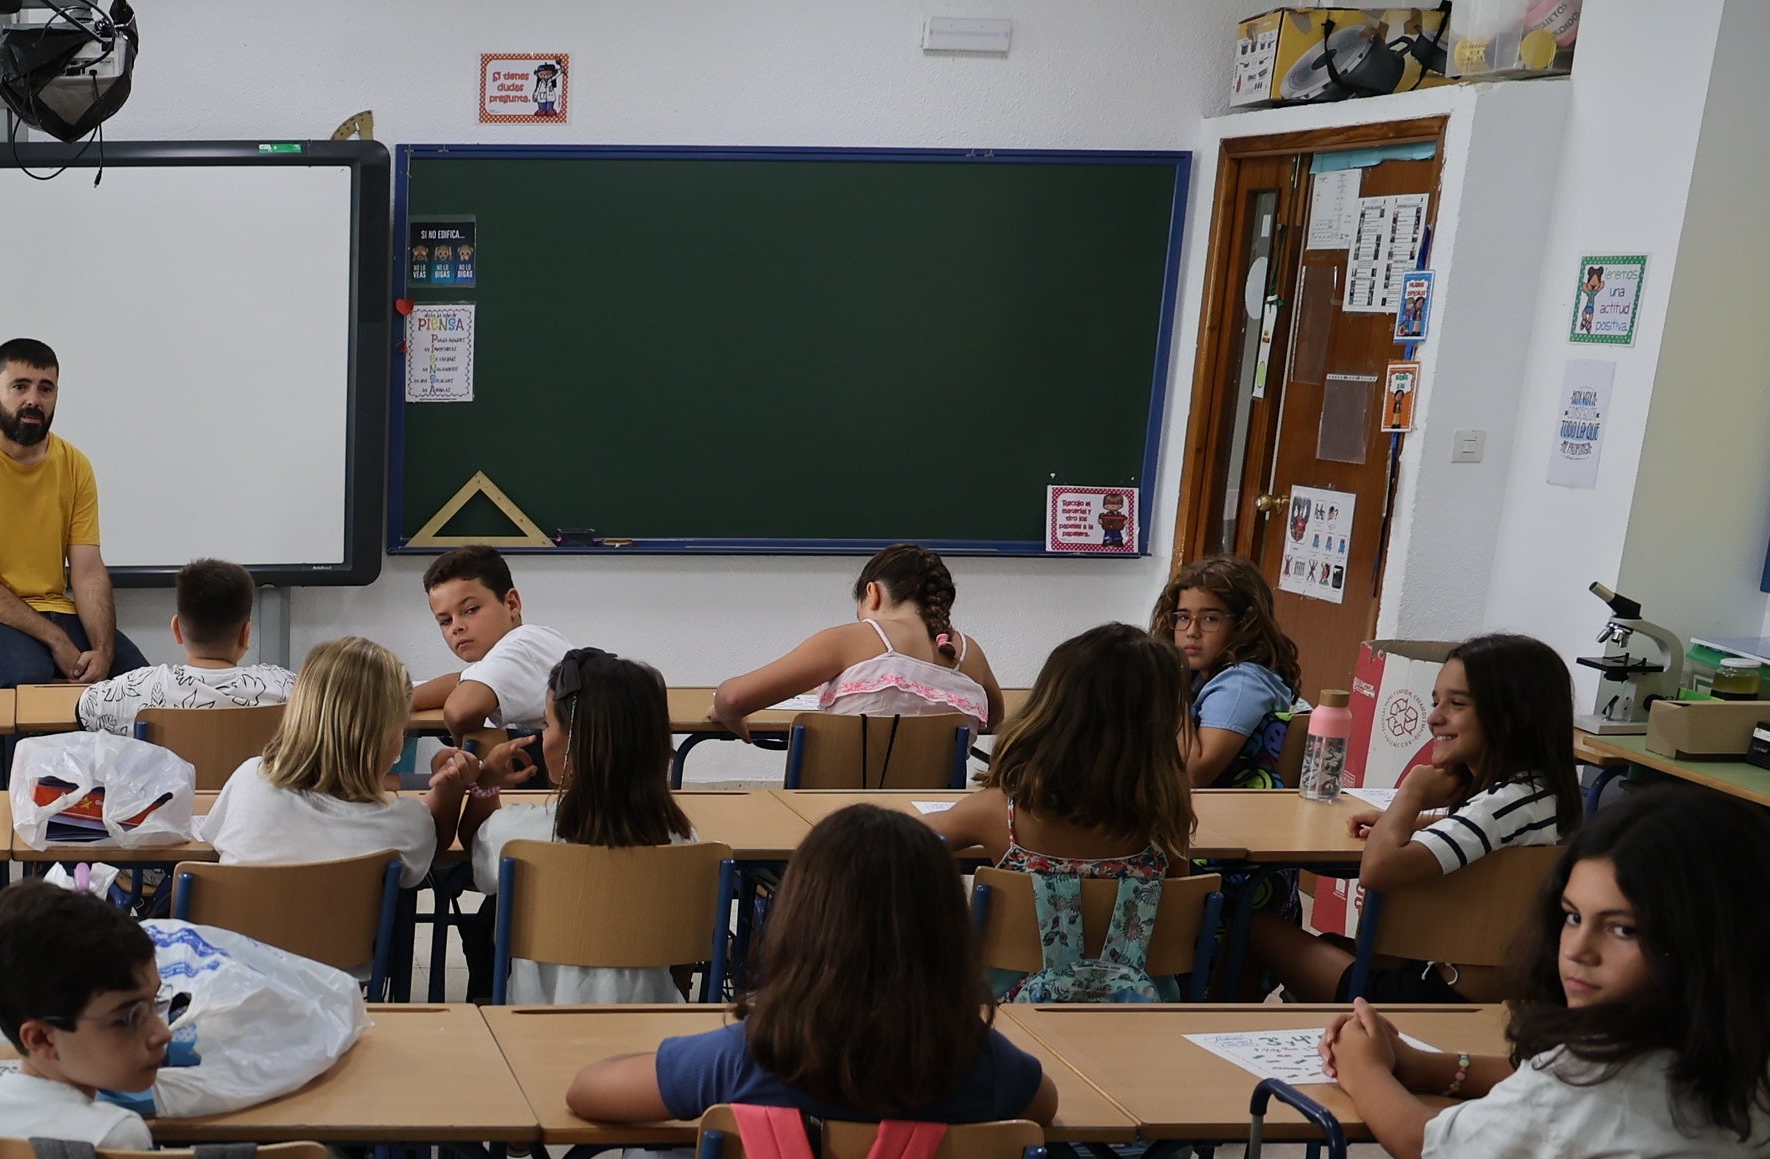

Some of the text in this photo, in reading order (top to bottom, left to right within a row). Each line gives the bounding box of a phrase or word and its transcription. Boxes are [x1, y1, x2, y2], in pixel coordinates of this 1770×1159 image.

[497, 82, 525, 92] dudas
[489, 94, 531, 104] pregunta.
[421, 230, 427, 239] SI
[428, 230, 437, 239] NO
[1610, 287, 1626, 298] una
[1599, 302, 1631, 315] actitud
